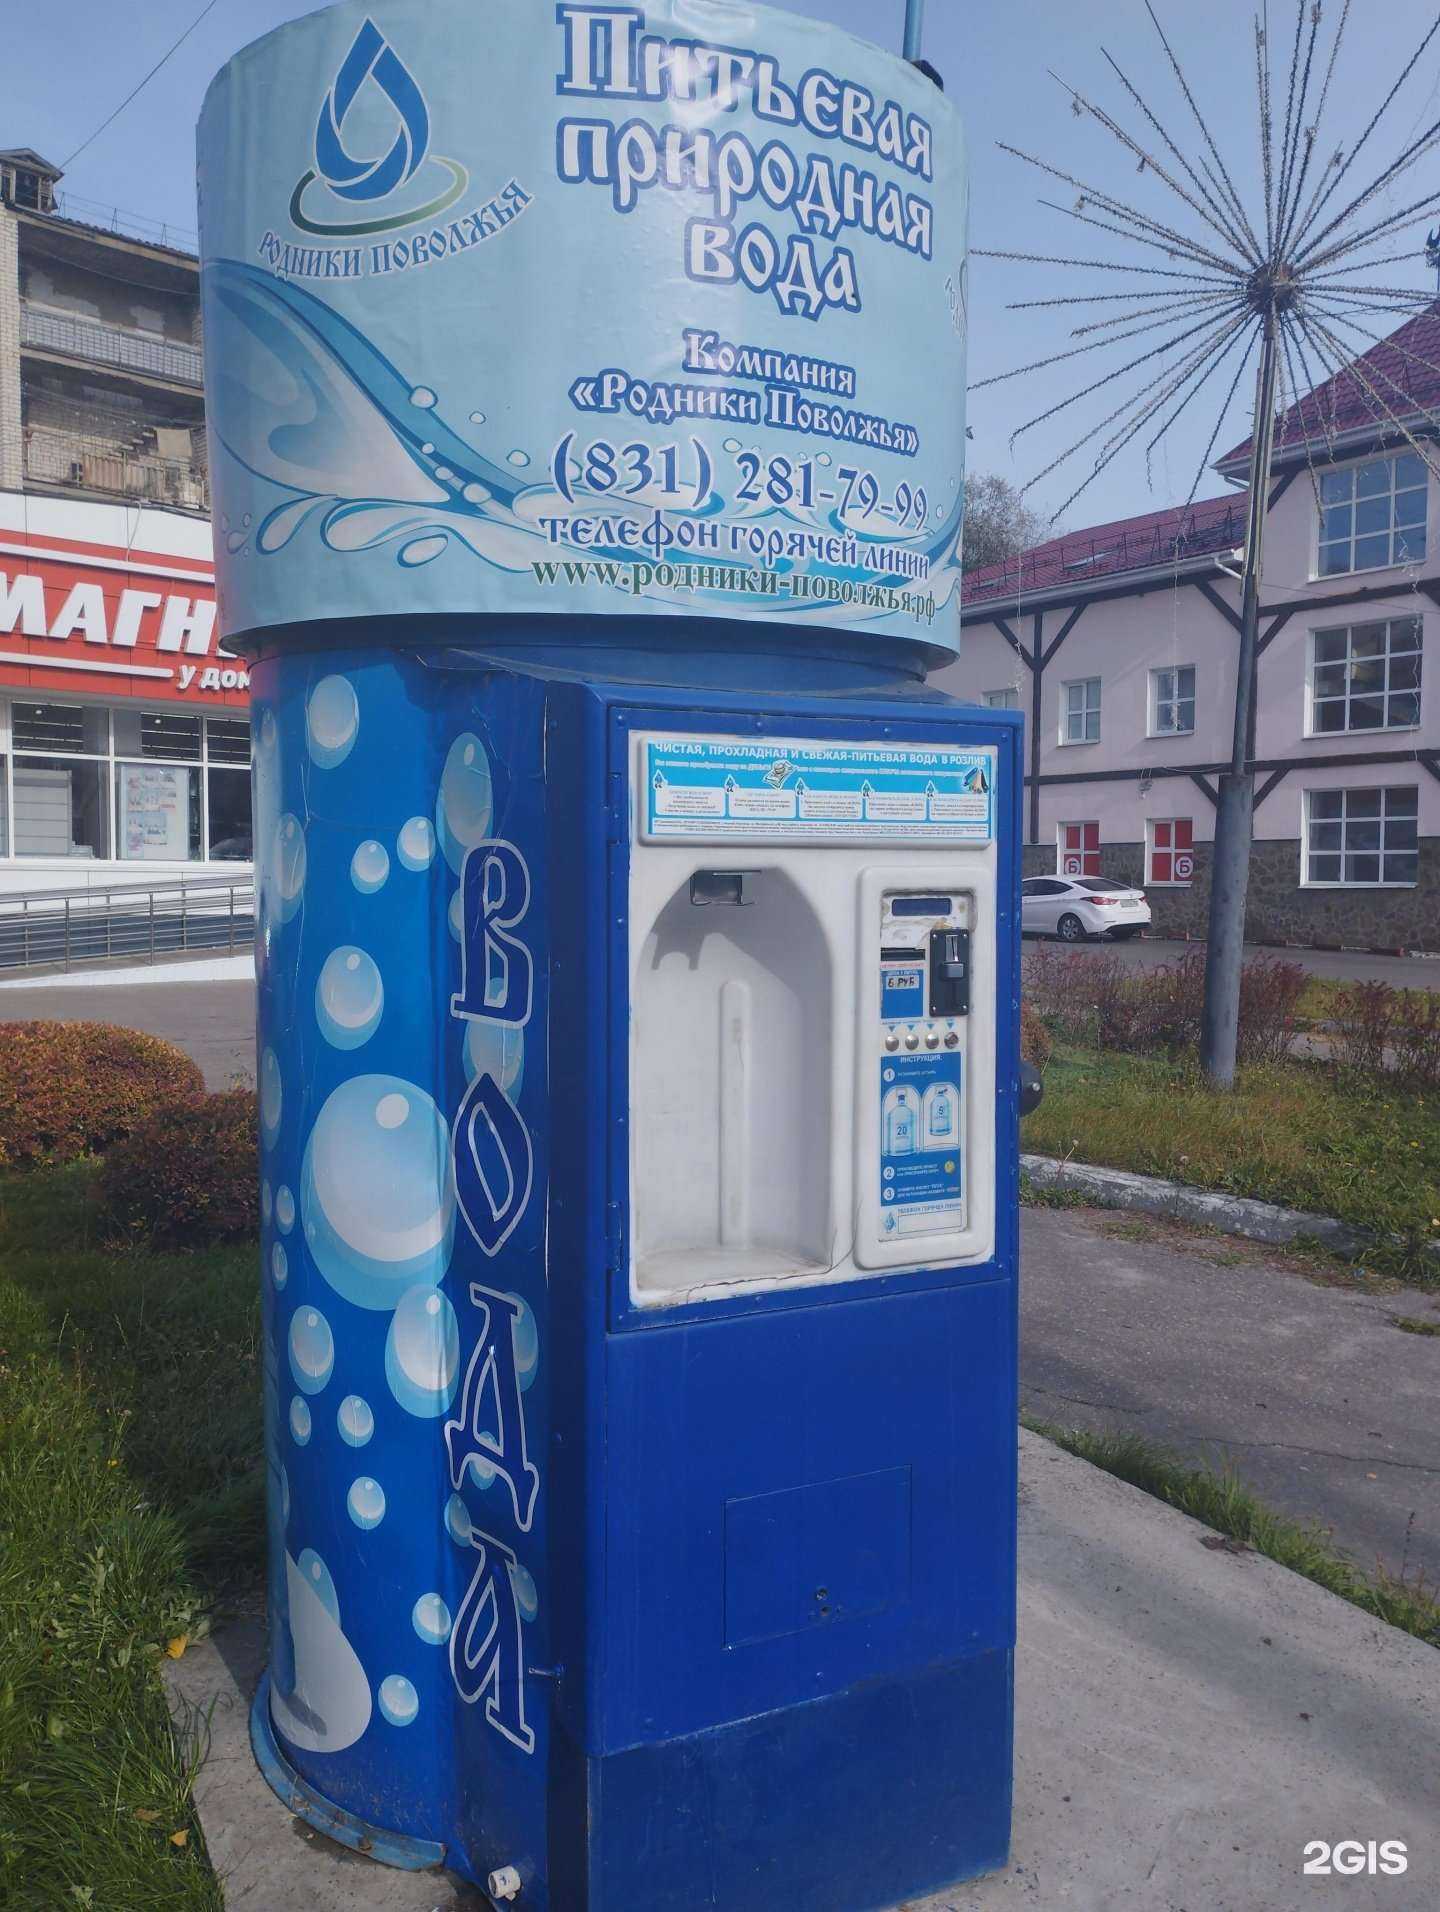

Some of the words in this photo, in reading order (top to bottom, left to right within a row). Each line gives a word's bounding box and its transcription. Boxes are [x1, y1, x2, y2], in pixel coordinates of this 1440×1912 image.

[558, 6, 932, 180] Питьевая
[259, 231, 362, 279] РОДНИКИ
[371, 181, 533, 274] ПОВОЛЖЬЯ
[558, 119, 932, 259] природная
[687, 217, 861, 320] вода
[684, 329, 855, 397] Компания
[570, 369, 758, 423] «Родники
[766, 385, 918, 456] Поволжья»
[554, 433, 712, 509] (831)
[736, 452, 928, 530] 281-79-99
[539, 510, 719, 558] телефон
[730, 525, 857, 567] горячей
[864, 546, 929, 580] линии
[0, 572, 238, 658] МАГН
[709, 746, 788, 760] ПРОХЛАДНАЯ
[790, 749, 799, 759] И
[910, 754, 938, 765] ВОДА
[941, 755, 948, 765] В
[950, 755, 987, 766] РОЗЛИВ
